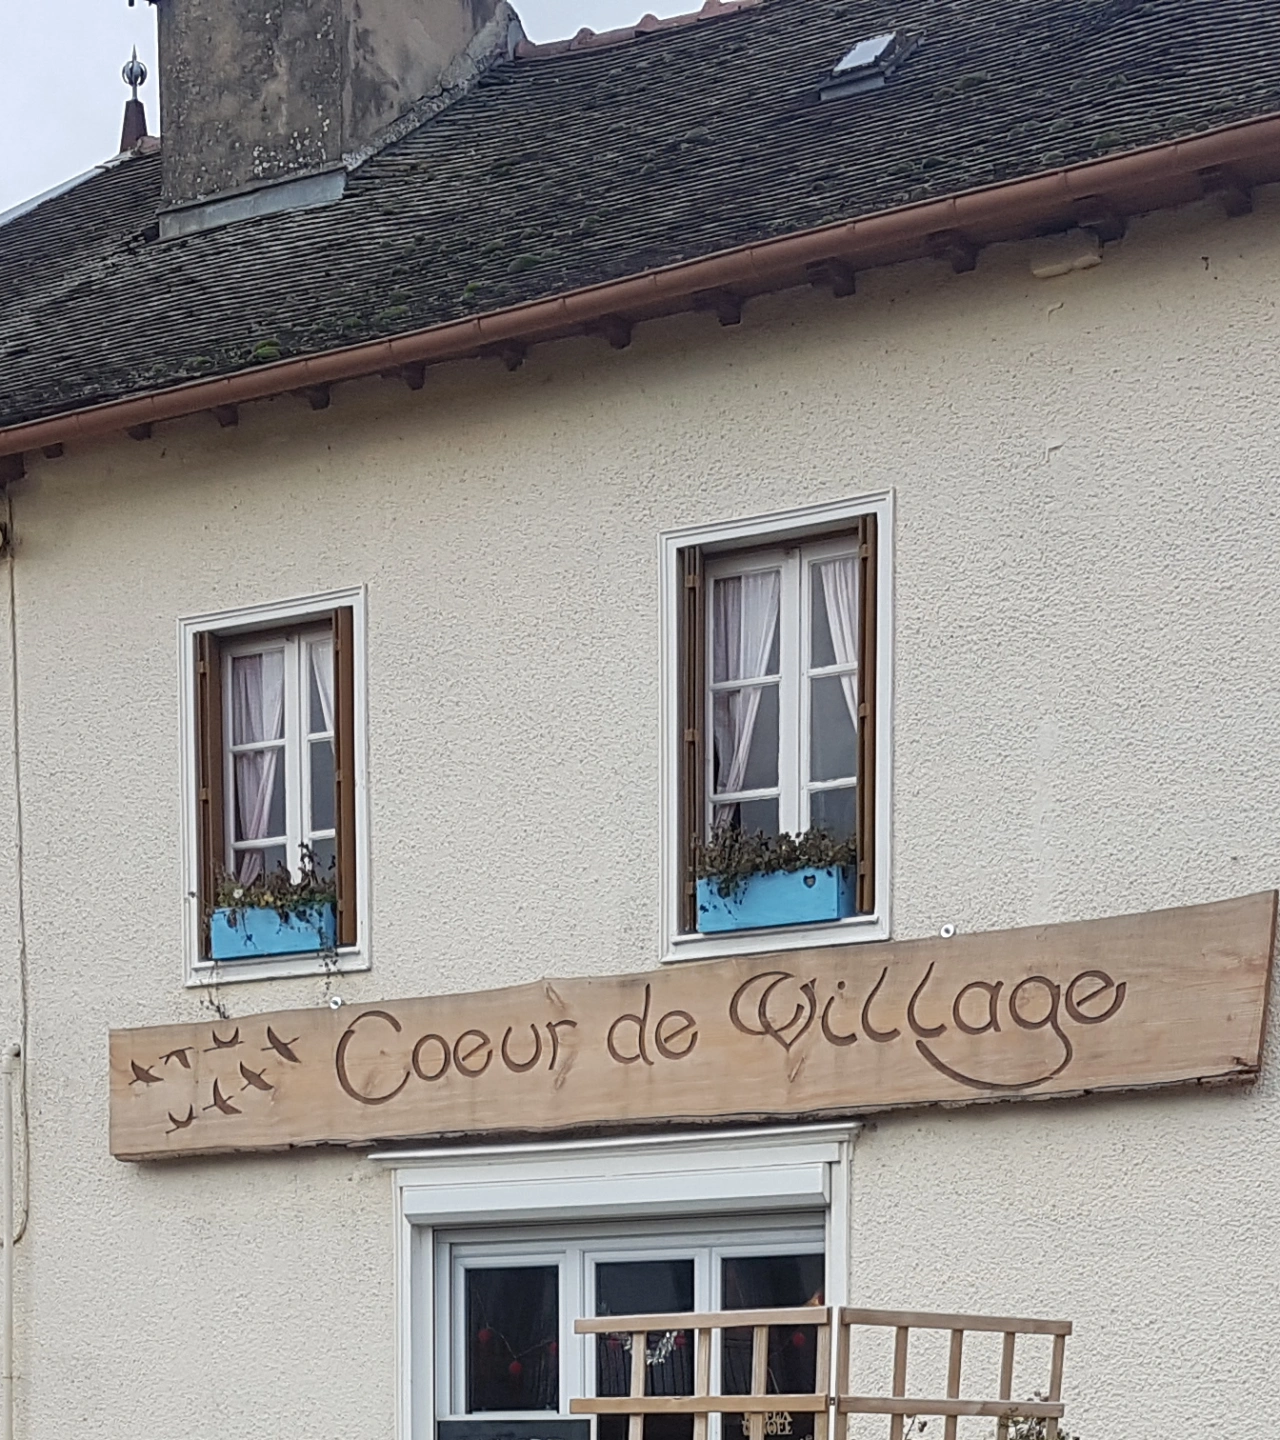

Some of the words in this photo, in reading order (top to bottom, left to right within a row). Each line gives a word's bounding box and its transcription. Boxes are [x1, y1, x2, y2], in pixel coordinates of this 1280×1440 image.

[335, 1009, 578, 1106] Coeur
[607, 983, 699, 1066] de
[729, 961, 1127, 1090] Village
